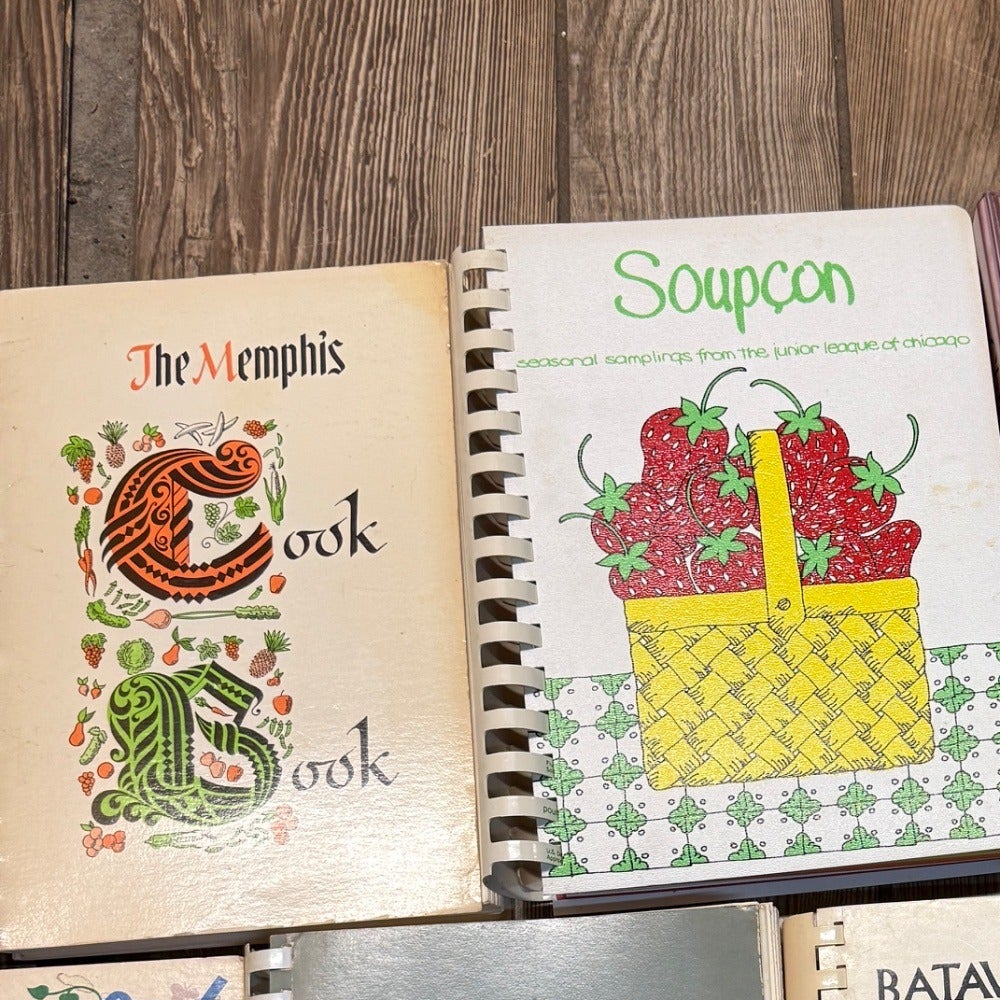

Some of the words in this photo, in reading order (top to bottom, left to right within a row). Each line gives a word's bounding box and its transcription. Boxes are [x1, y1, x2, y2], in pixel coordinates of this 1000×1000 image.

[613, 249, 856, 333] Soupçon
[126, 342, 191, 391] The
[192, 330, 346, 390] Memphis
[516, 354, 598, 368] seasonal
[605, 351, 693, 366] samplings
[697, 348, 736, 364] from
[738, 346, 769, 360] the
[774, 342, 819, 360] junior
[824, 338, 880, 354] league
[881, 337, 900, 351] of
[903, 335, 971, 348] chicago
[100, 439, 387, 603] Cook
